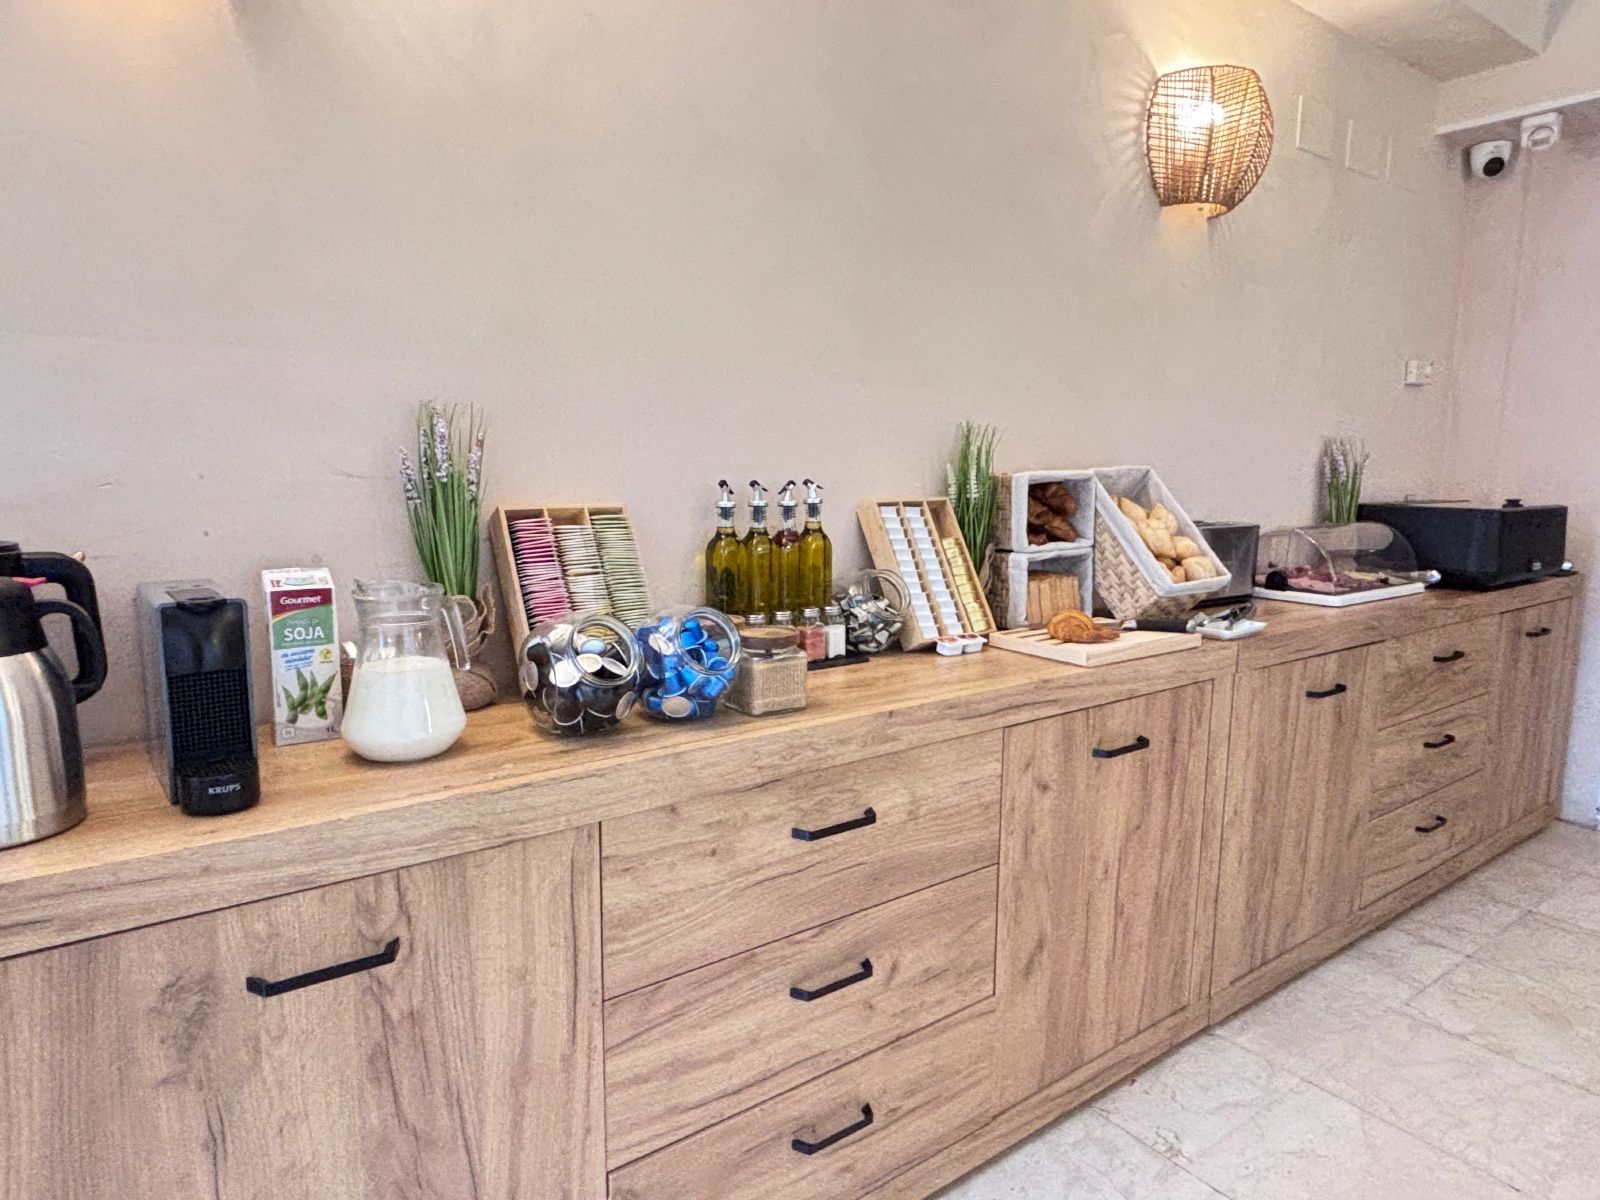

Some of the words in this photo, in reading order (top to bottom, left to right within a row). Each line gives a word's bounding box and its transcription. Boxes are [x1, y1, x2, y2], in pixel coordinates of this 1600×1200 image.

[280, 595, 322, 605] Gourmet
[283, 626, 325, 642] SOJA
[207, 784, 242, 795] KRUPS
